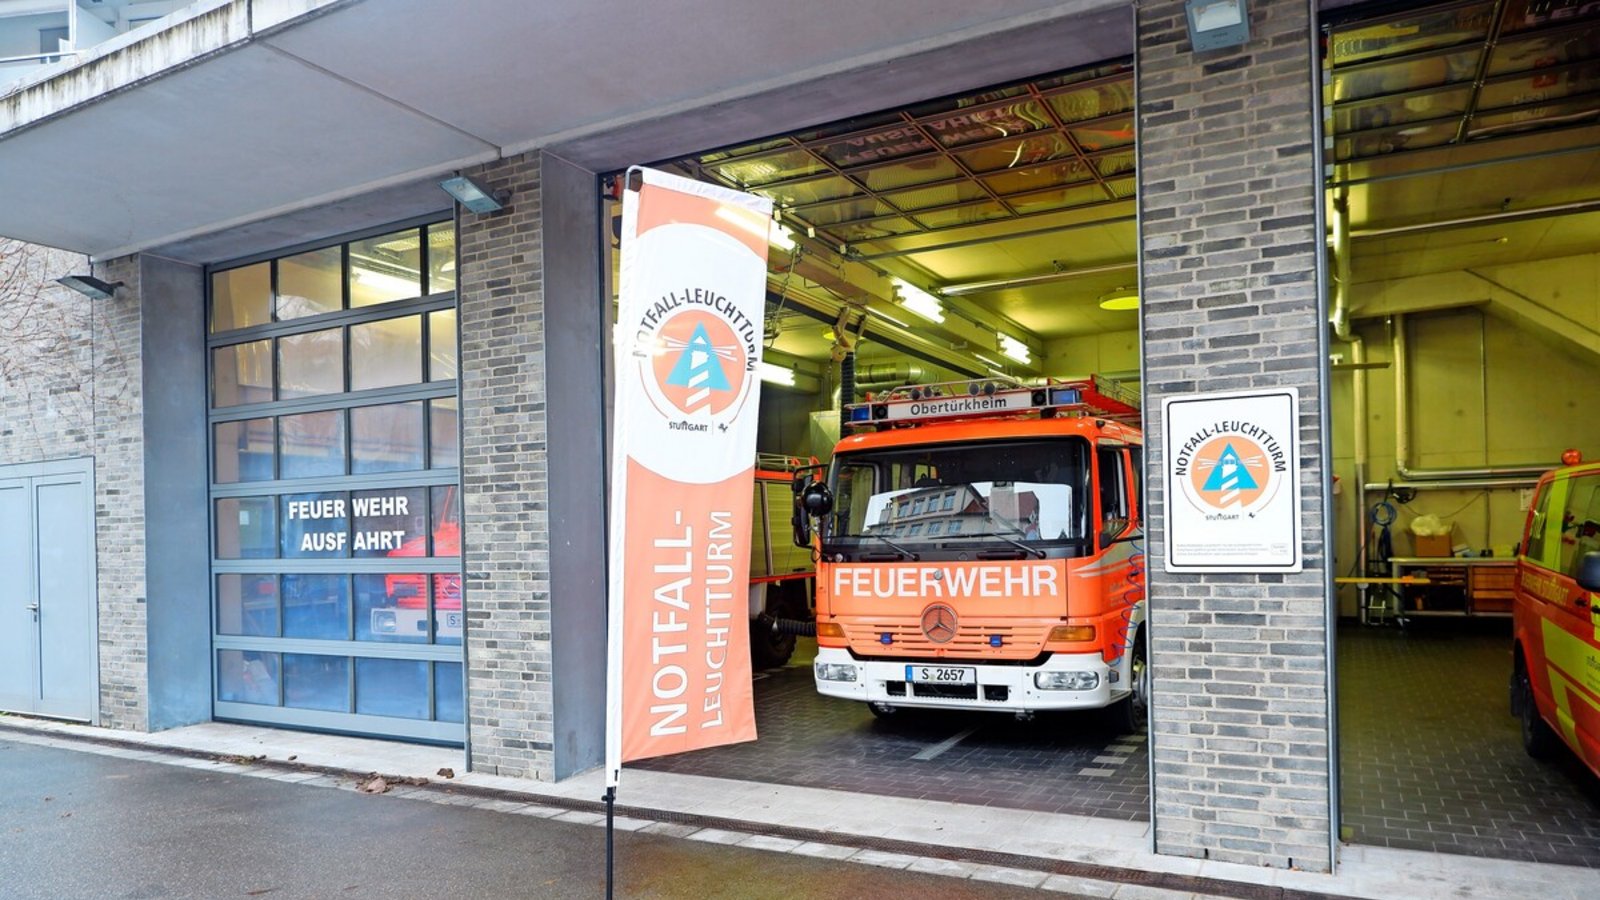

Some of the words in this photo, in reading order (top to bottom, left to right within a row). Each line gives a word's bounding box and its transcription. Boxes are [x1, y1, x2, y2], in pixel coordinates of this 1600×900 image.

[911, 396, 1007, 416] Obertürkheim
[669, 421, 708, 432] STUTTGART
[1175, 420, 1287, 476] NOTFALL-LEUCHTTURM
[288, 499, 346, 519] FEUER
[352, 496, 409, 518] WEHR
[1205, 513, 1240, 521] STUTTGART
[300, 532, 347, 551] AUSF
[353, 530, 405, 550] AHRT
[834, 565, 1058, 598] FEUERWEHR
[650, 510, 692, 737] NOTFALL-
[701, 511, 733, 728] LEUCHTTURM
[937, 669, 965, 681] 2657
